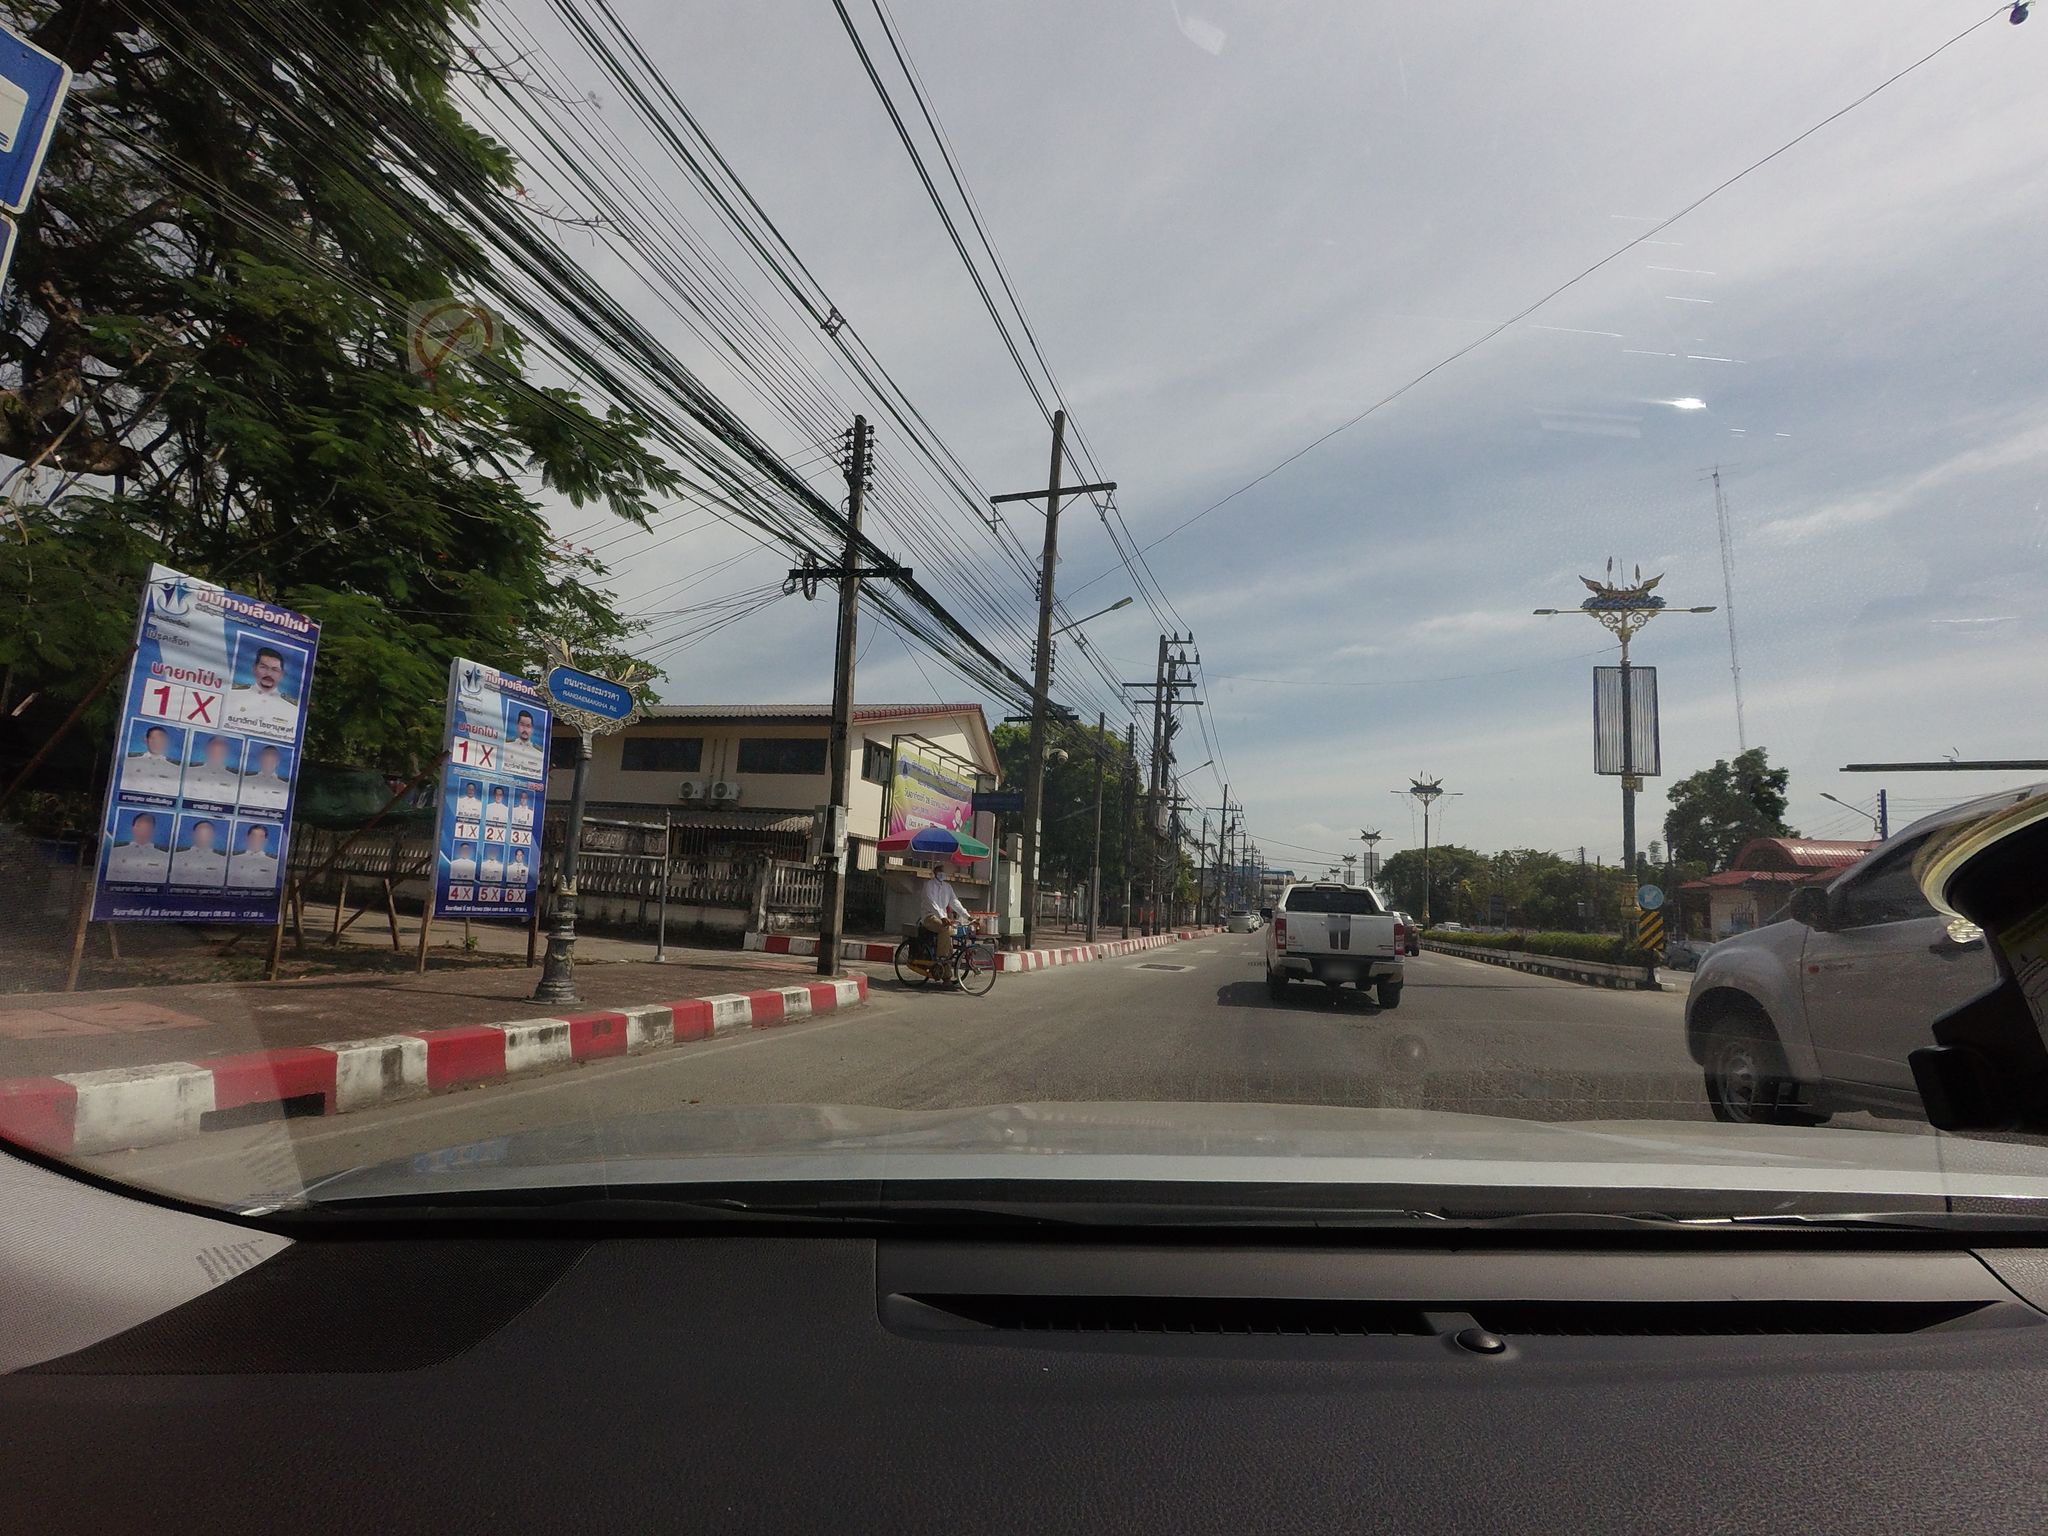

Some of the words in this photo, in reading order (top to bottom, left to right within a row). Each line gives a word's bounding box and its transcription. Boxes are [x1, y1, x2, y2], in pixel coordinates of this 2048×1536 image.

[153, 685, 171, 716] 1
[458, 740, 469, 763] 1
[458, 825, 464, 837] 1
[486, 827, 494, 840] 2
[512, 831, 520, 843] 3
[450, 887, 460, 900] 4
[480, 887, 488, 900] 5
[506, 889, 514, 902] 6
